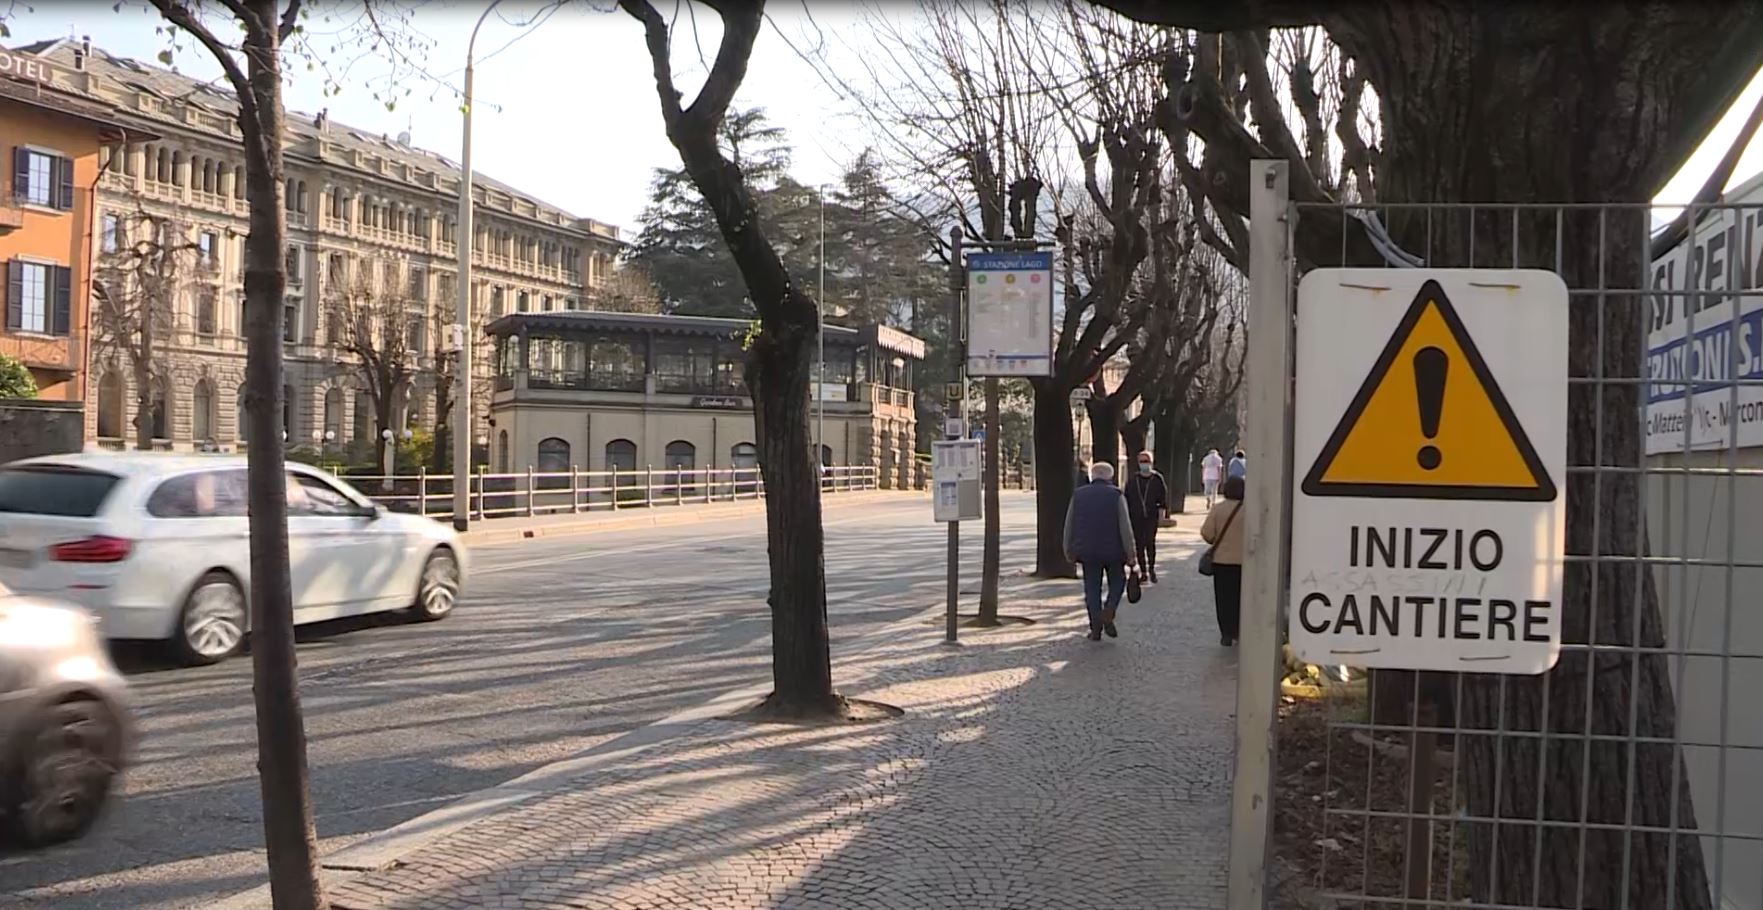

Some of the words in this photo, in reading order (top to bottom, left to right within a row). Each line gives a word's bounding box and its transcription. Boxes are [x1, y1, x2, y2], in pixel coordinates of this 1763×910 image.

[983, 260, 1018, 270] STAZIONE
[1021, 260, 1042, 269] LAGO
[1349, 525, 1504, 572] INIZIO
[1299, 591, 1552, 642] CANTIERE
